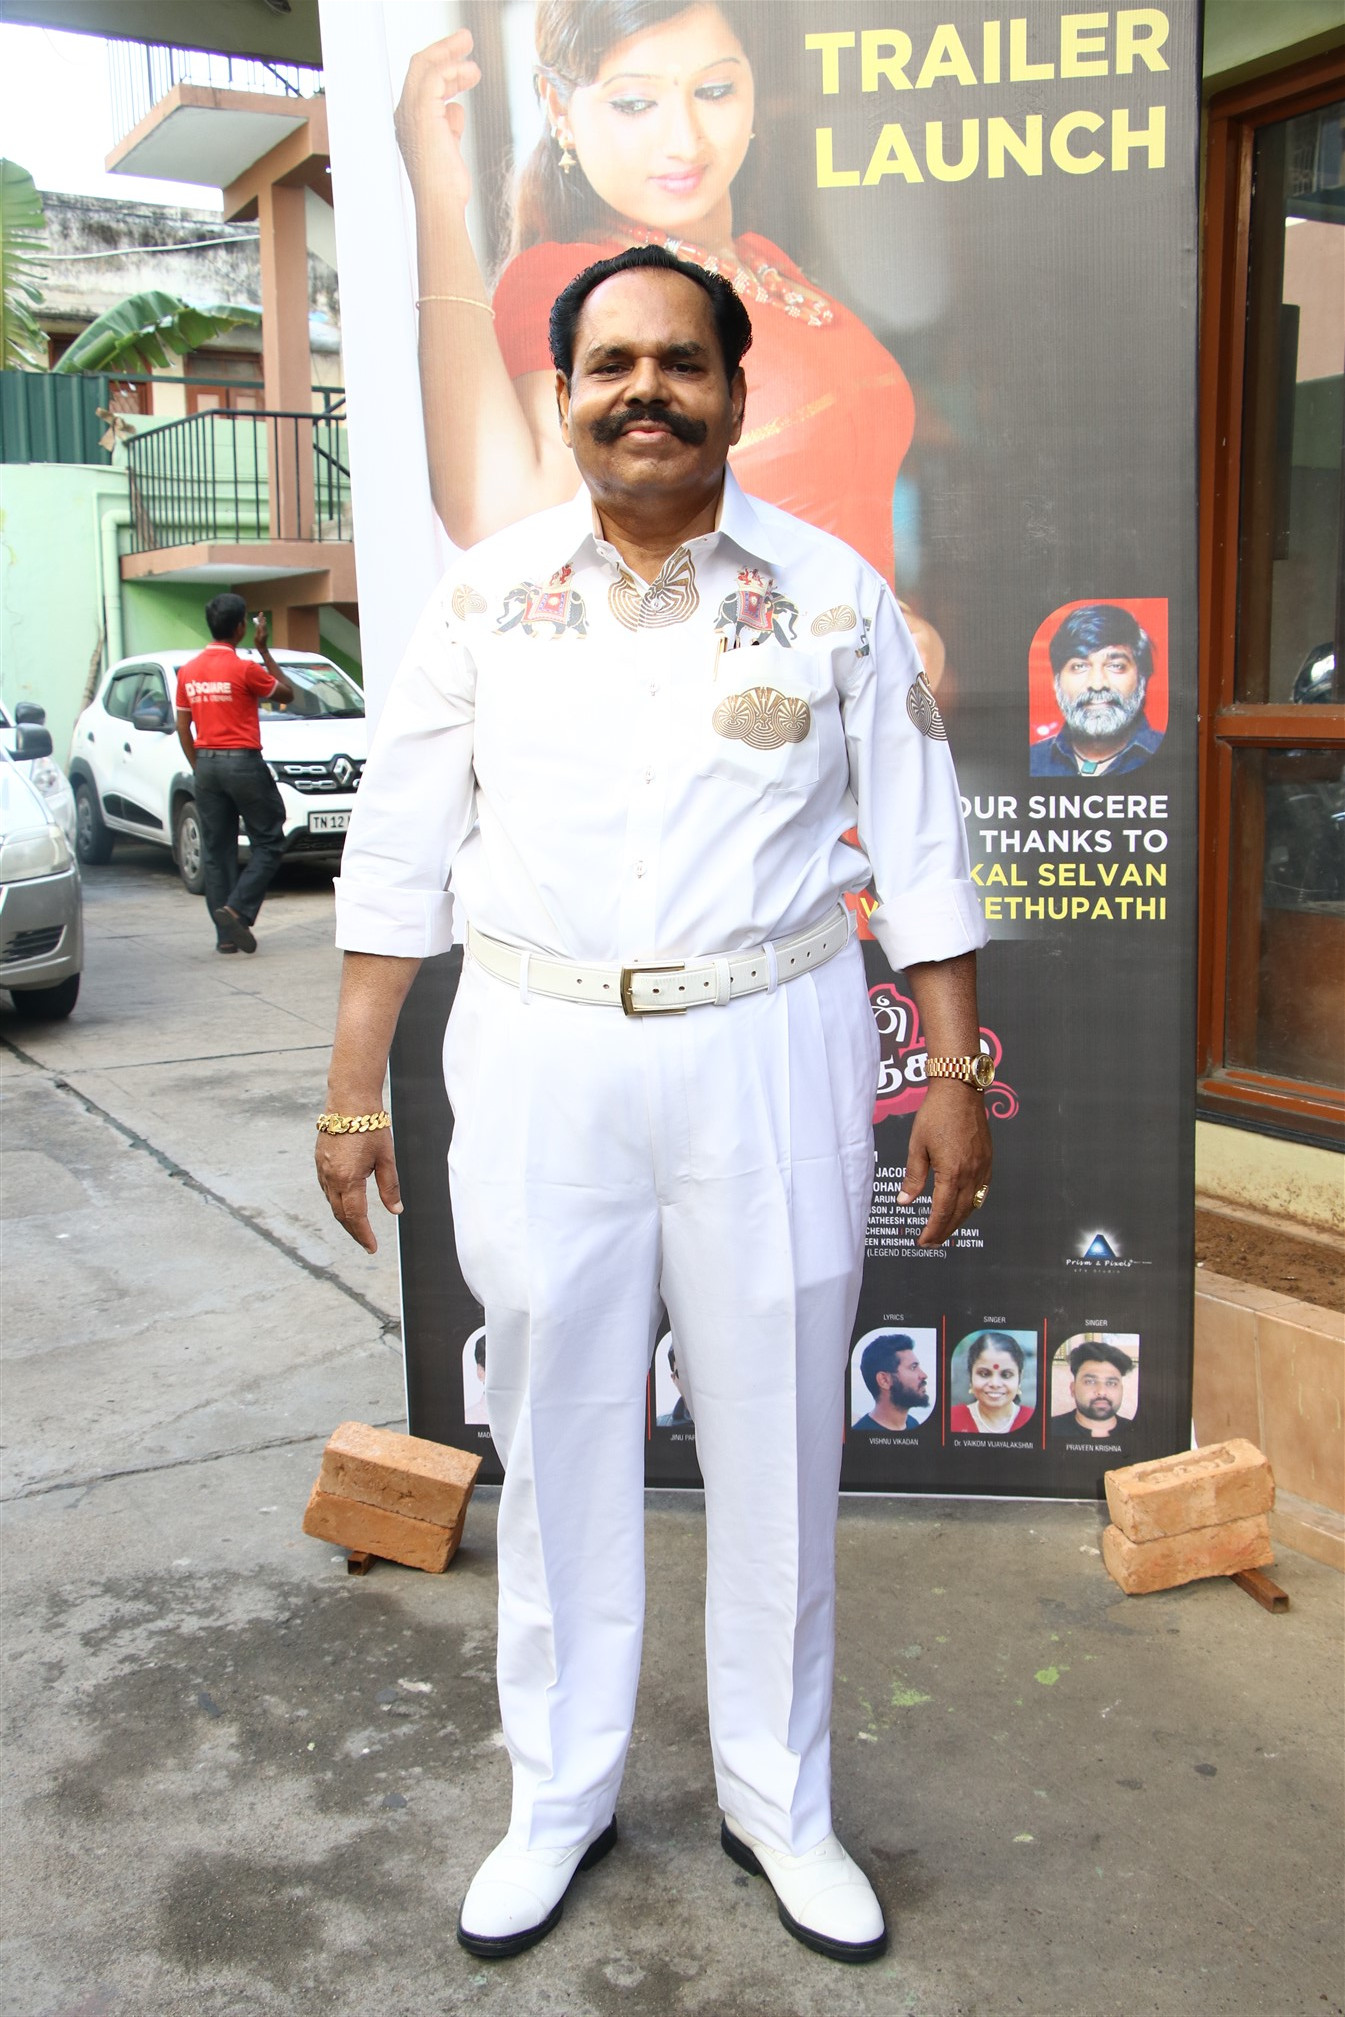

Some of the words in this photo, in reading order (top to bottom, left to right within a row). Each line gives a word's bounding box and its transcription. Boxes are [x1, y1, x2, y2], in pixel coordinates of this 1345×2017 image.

[805, 8, 1170, 95] TRAILER
[816, 105, 1166, 188] LAUNCH
[1028, 795, 1168, 819] SINCERE
[313, 816, 327, 828] TN
[330, 816, 344, 828] 12
[979, 829, 1112, 853] THANKS
[1123, 829, 1168, 853] TO
[1038, 863, 1167, 887] SELVAN
[978, 896, 1166, 920] ETHUPATHI
[873, 1181, 903, 1192] OHAN
[874, 1195, 896, 1203] ARUN
[889, 1206, 894, 1214] J
[896, 1206, 916, 1215] PAUL
[865, 1227, 899, 1236] CHENNAI
[905, 1227, 921, 1236] PRO
[961, 1228, 979, 1237] RAVI
[881, 1238, 916, 1247] KRISHNA
[956, 1239, 984, 1248] JUSTIN
[866, 1248, 900, 1257] (LEGEND
[1085, 1319, 1108, 1327] SINGER
[869, 1437, 891, 1445] VISHNU
[1066, 1443, 1094, 1452] PRAVEEN
[1095, 1444, 1122, 1453] KRISHNA
